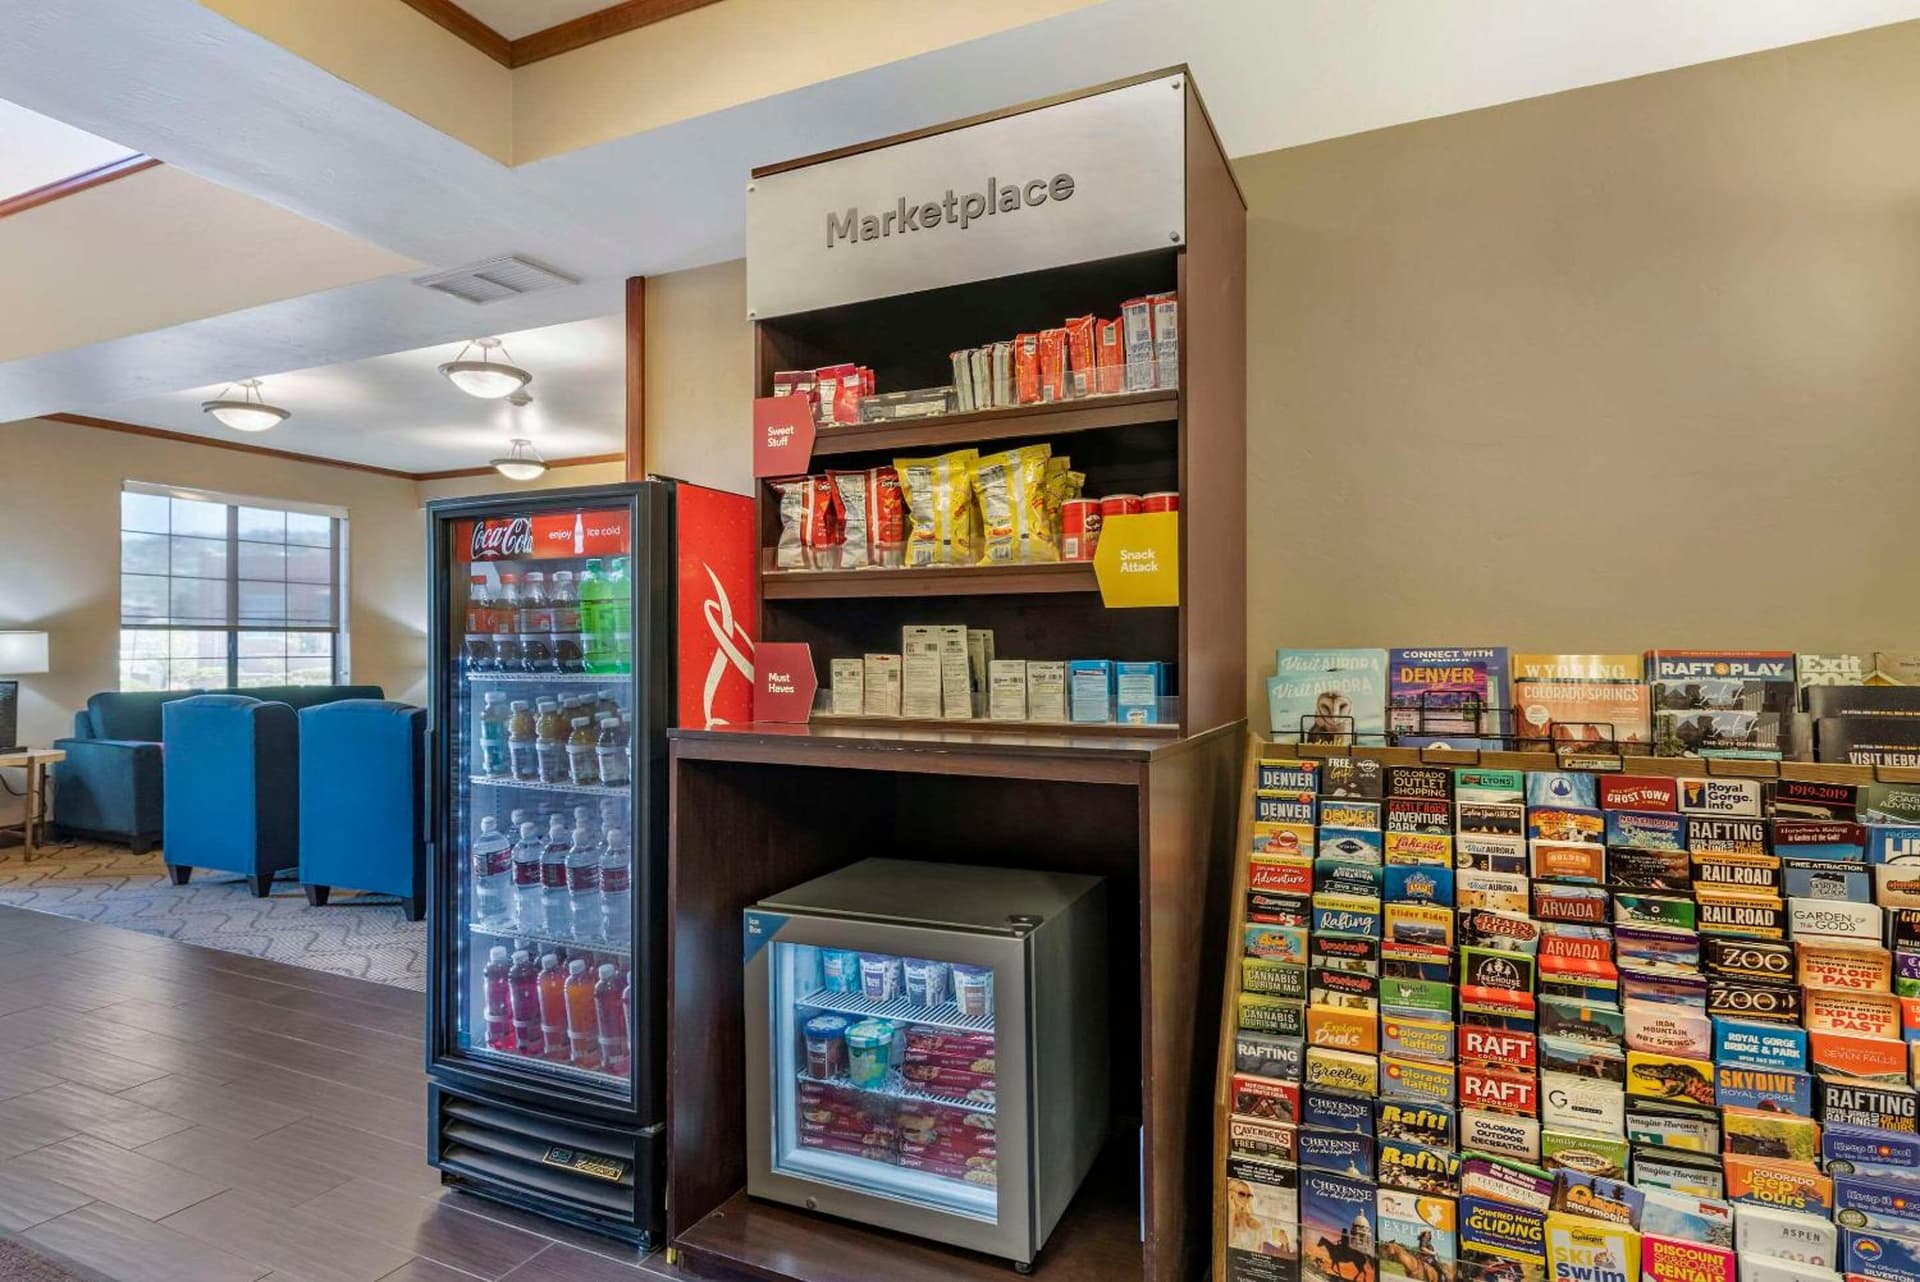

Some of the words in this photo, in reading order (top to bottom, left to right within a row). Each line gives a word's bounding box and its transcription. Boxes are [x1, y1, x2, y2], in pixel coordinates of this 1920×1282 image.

[826, 172, 1075, 248] Marketplace
[767, 425, 794, 437] Sweet
[767, 436, 788, 447] Stuff
[548, 529, 572, 541] enjoy
[587, 527, 600, 537] ice
[601, 526, 621, 536] cold
[1120, 548, 1157, 561] Snack
[1120, 561, 1159, 573] Attack
[1402, 650, 1459, 659] CONNECT
[1462, 649, 1494, 658] WITH
[1282, 656, 1322, 672] Visit
[1321, 655, 1379, 671] AURORA
[1661, 662, 1714, 675] RAFT
[1730, 663, 1785, 676] PLAY
[1801, 654, 1861, 672] Exit
[768, 672, 790, 683] Must
[1401, 667, 1475, 684] DENVER
[768, 683, 795, 694] Haves
[1273, 682, 1315, 698] Visit
[1315, 677, 1373, 695] AURORA
[1524, 686, 1585, 701] COLORADO
[1587, 687, 1640, 702] SPRINGS
[1328, 758, 1351, 768] FREE
[1849, 752, 1880, 765] VISIT
[1264, 771, 1314, 786] DENVER
[1392, 769, 1446, 779] COLORADO
[1481, 776, 1512, 785] LYONS
[1394, 777, 1446, 789] OUTLET
[1707, 782, 1743, 793] Royal
[1393, 786, 1446, 798] SHOPPING
[1607, 792, 1639, 804] GHOST
[1640, 790, 1671, 802] TOWN
[1789, 784, 1848, 799] 1919-2019
[1261, 802, 1311, 818] DENVER
[1389, 801, 1421, 812] CASTLE
[1423, 803, 1447, 813] ROCK
[1708, 800, 1734, 810] info
[1323, 809, 1375, 823] DENVER
[1388, 812, 1449, 825] ADVENTURE
[1389, 822, 1417, 831] PARK
[1689, 822, 1763, 841] RAFTING
[1388, 836, 1446, 854] Lakeside
[1486, 846, 1516, 855] AURORA
[1702, 864, 1773, 885] RAILROAD
[1812, 862, 1863, 872] ATTRACTION
[1253, 870, 1305, 884] Adventure
[1488, 883, 1518, 893] AURORA
[1390, 909, 1419, 918] Glider
[1423, 911, 1449, 922] Rides
[1541, 901, 1594, 918] ARVADA
[1702, 905, 1774, 926] RAILROAD
[1794, 910, 1852, 922] GARDEN
[1320, 912, 1374, 934] Rafting
[1482, 915, 1530, 931] TRAIN
[1632, 914, 1680, 924] DOWNTOWN
[1815, 920, 1856, 932] GODS
[1481, 921, 1531, 938] RIDES
[1546, 941, 1600, 960] ARVADA
[1722, 948, 1789, 972] ZOO
[1806, 959, 1847, 968] DISCOVER
[1248, 970, 1298, 985] CANNABIS
[1476, 973, 1520, 987] TREEHOUSE
[1806, 965, 1882, 980] EXPLORE
[1247, 979, 1281, 991] TOURISM
[1283, 984, 1301, 993] MAP
[1822, 975, 1877, 989] PAST
[1711, 989, 1775, 1011] ZOO
[1815, 1003, 1855, 1011] DISCOVER
[1244, 1009, 1295, 1024] CANNABIS
[1814, 1008, 1892, 1023] EXPLORE
[1280, 1022, 1298, 1031] MAP
[1323, 1021, 1364, 1034] Explore
[1643, 1026, 1688, 1036] MOUNTAIN
[1655, 1020, 1676, 1028] IRON
[1831, 1019, 1886, 1033] PAST
[1315, 1028, 1360, 1046] Deals
[1637, 1033, 1653, 1043] HOT
[1656, 1038, 1697, 1047] SPRINGS
[1728, 1032, 1760, 1044] ROYAL
[1762, 1037, 1796, 1048] GORGE
[1238, 1044, 1298, 1061] RAFTING
[1401, 1037, 1446, 1053] Rafting
[1467, 1033, 1532, 1059] RAFT
[1724, 1041, 1759, 1053] BRIDGE
[1761, 1046, 1770, 1055] &
[1772, 1047, 1800, 1058] PARK
[1478, 1054, 1520, 1064] COLORADO
[1824, 1048, 1859, 1060] SEVEN
[1863, 1053, 1897, 1066] FALLS
[1311, 1062, 1369, 1086] Greeley
[1402, 1078, 1448, 1096] Rafting
[1720, 1070, 1796, 1094] SKYDIVE
[1465, 1076, 1532, 1104] RAFT
[1720, 1088, 1756, 1099] ROYAL
[1757, 1092, 1797, 1103] GORGE
[1308, 1097, 1368, 1116] CHEYENNE
[1476, 1096, 1520, 1109] COLORADO
[1826, 1087, 1916, 1117] RAFTING
[1382, 1105, 1447, 1131] Raft!
[1629, 1117, 1662, 1128] Imagine
[1474, 1120, 1526, 1136] COLORADO
[1301, 1136, 1360, 1152] CHEYENNE
[1471, 1135, 1529, 1153] RECREATION
[1476, 1129, 1524, 1145] OUTDOOR
[1637, 1163, 1672, 1176] Imagine
[1753, 1168, 1815, 1186] COLORADO
[1311, 1178, 1373, 1201] CHEYENNE
[1741, 1170, 1794, 1195] Jeep
[1750, 1184, 1806, 1209] Tours
[1472, 1206, 1514, 1221] POWERED
[1515, 1214, 1540, 1226] HANG
[1566, 1201, 1630, 1224] snowmobile
[1469, 1215, 1543, 1240] GLIDING
[1783, 1227, 1821, 1242] ASPEN
[1653, 1242, 1725, 1265] DISCOUNT
